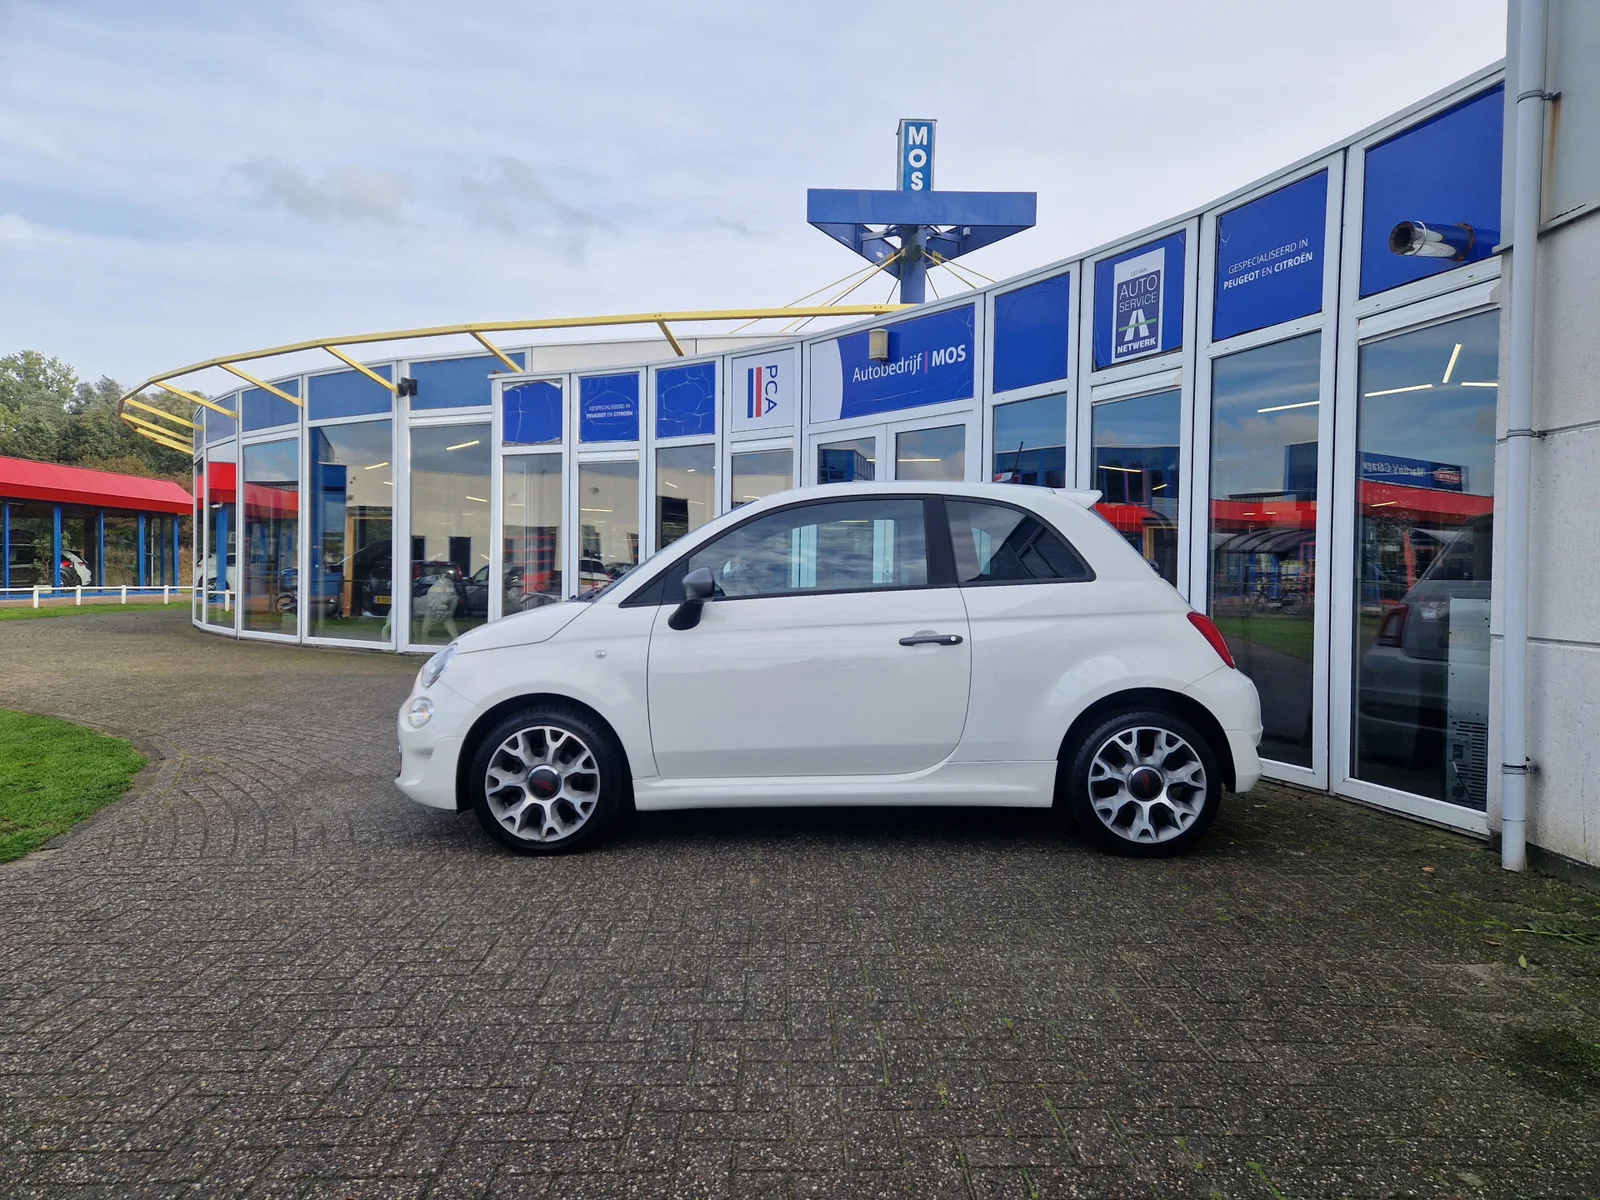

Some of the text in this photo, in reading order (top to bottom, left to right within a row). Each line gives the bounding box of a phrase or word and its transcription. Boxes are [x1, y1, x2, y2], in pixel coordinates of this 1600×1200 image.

[908, 126, 928, 191] MOS
[1223, 251, 1313, 290] PEUGEOT EN CITROËN
[1228, 237, 1309, 275] GESPECIALISEERD IN
[1118, 291, 1157, 313] SERVICE
[1119, 274, 1158, 300] AUTO
[852, 344, 967, 383] Autobedrijf MOS
[1117, 336, 1157, 354] NETWERK
[764, 364, 779, 414] PCA
